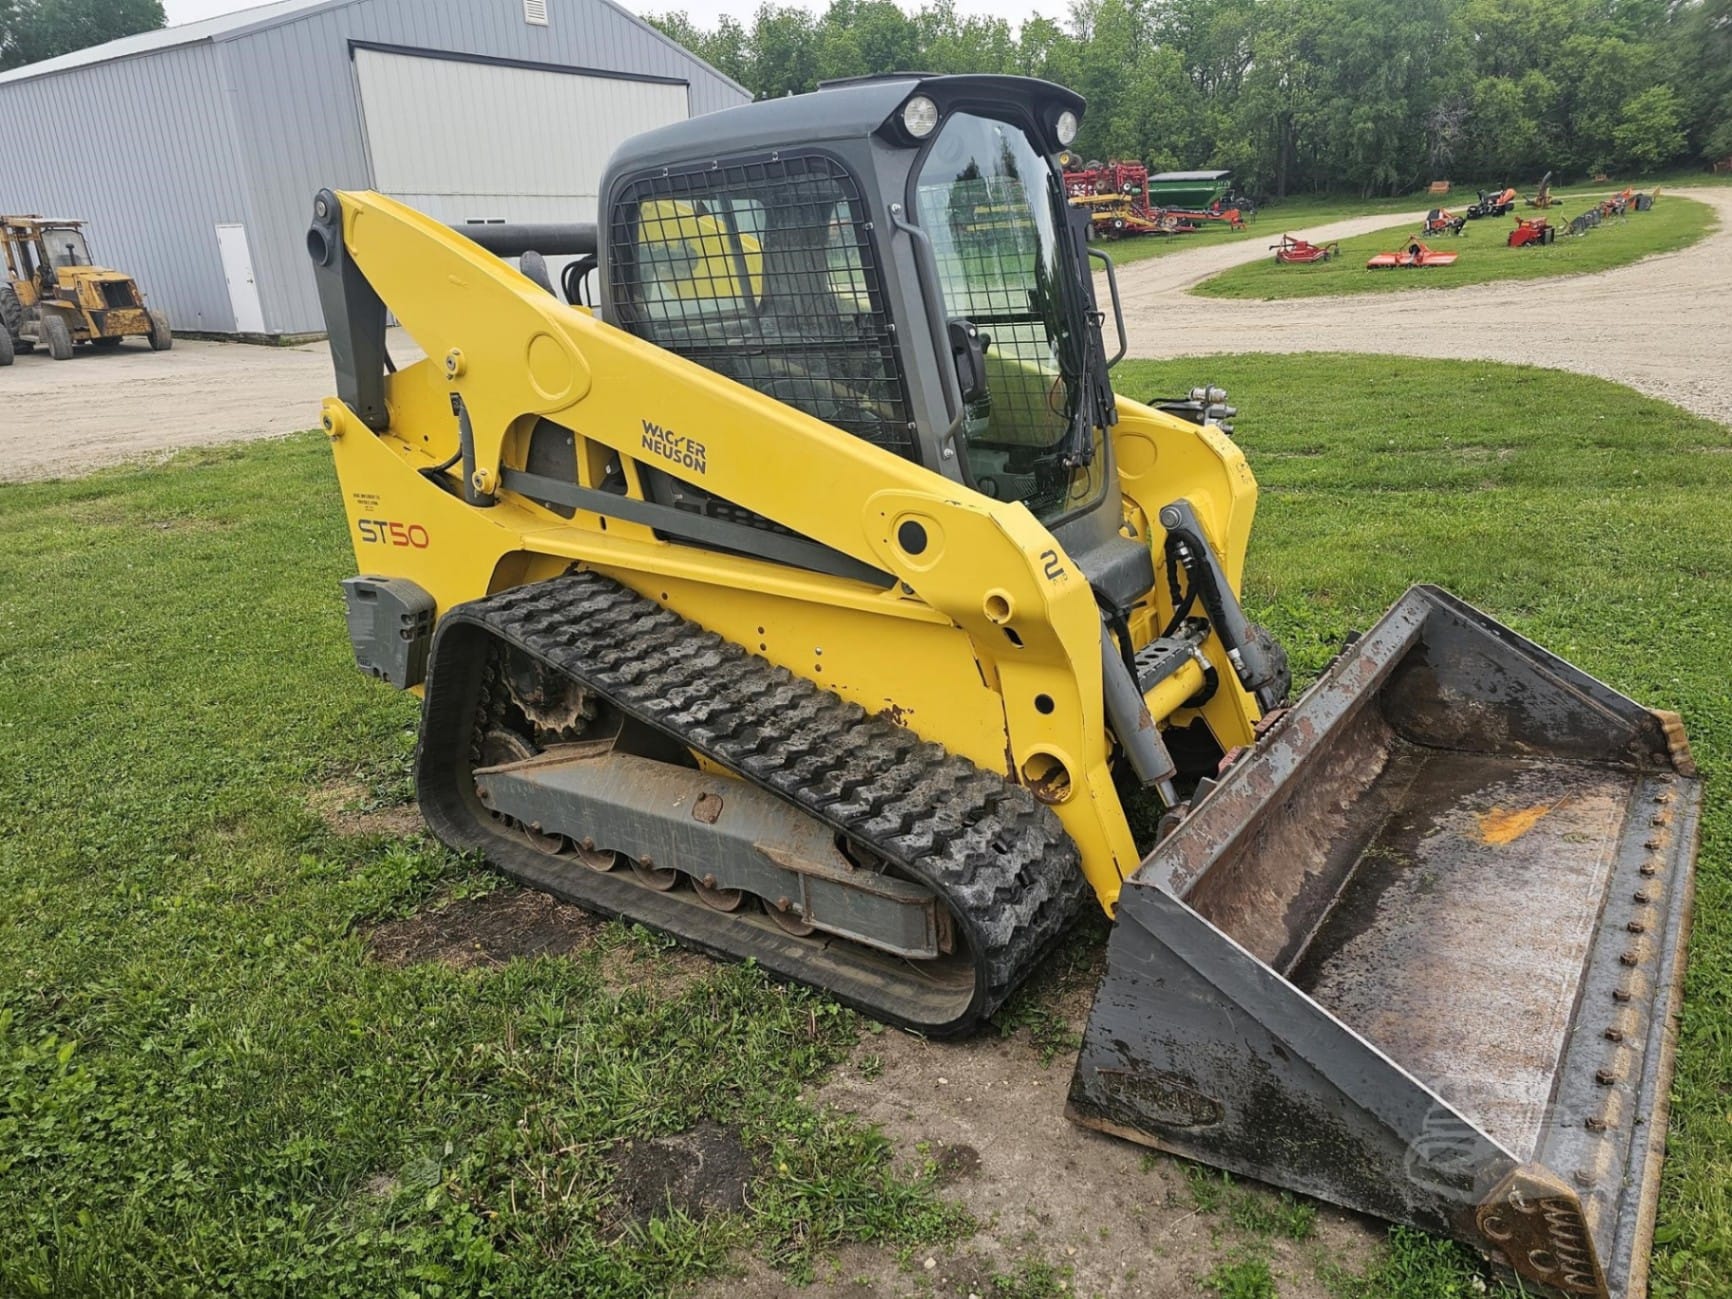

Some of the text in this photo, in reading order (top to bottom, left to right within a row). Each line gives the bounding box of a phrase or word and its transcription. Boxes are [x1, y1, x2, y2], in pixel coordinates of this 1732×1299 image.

[642, 419, 706, 460] WACKER
[642, 435, 706, 474] NEUSON
[358, 519, 429, 549] ST50
